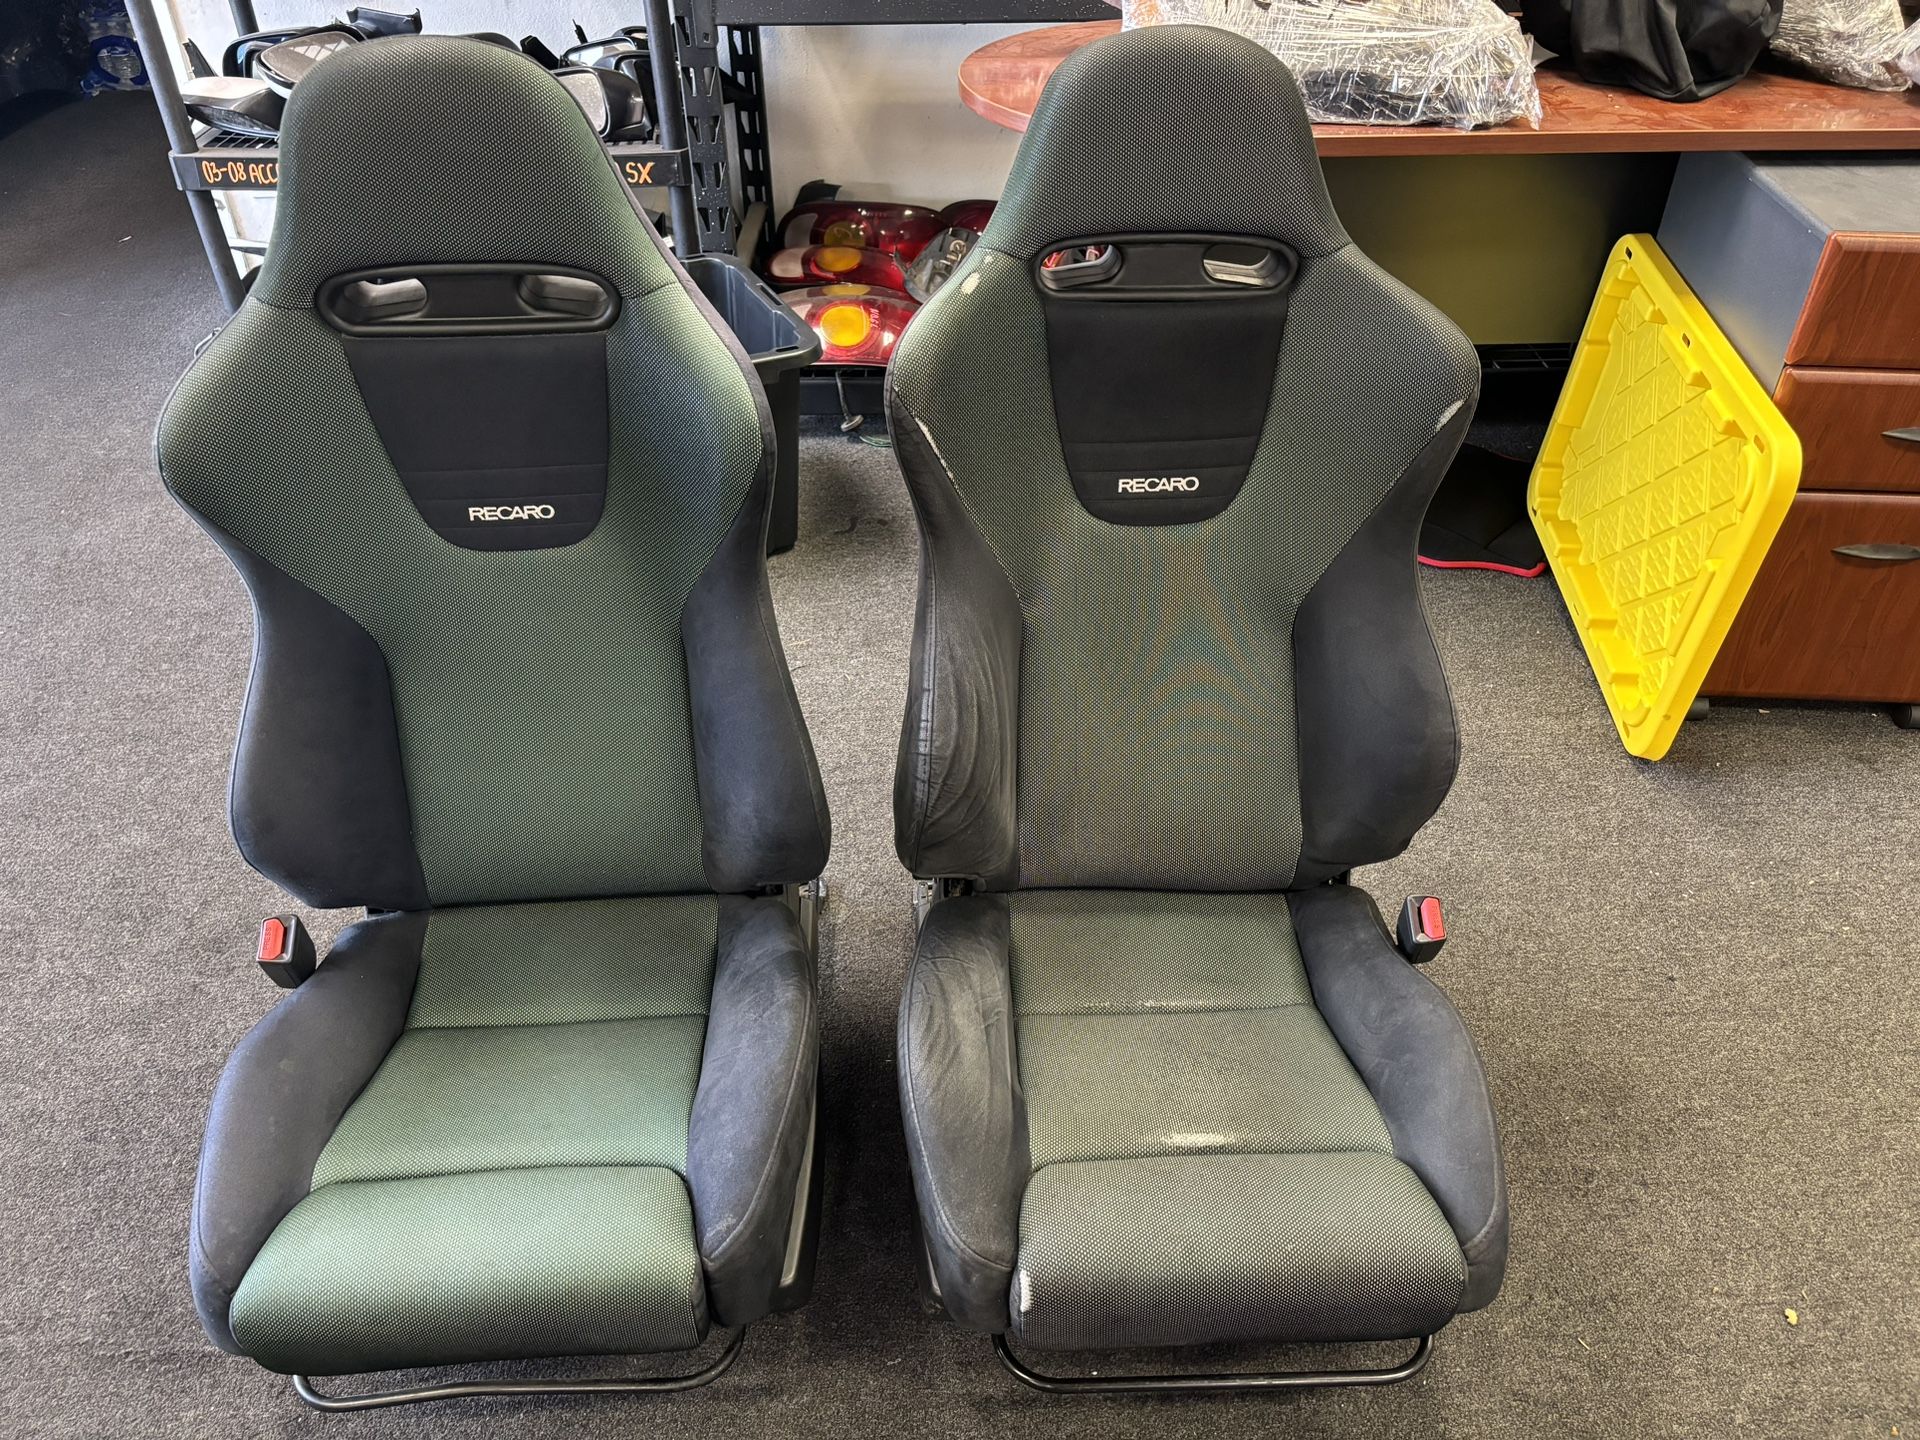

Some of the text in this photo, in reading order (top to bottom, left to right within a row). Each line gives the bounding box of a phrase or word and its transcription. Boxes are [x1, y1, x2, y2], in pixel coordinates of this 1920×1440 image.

[202, 160, 247, 183] 03-08
[625, 161, 655, 184] SX
[1117, 476, 1200, 493] RECARO
[467, 504, 555, 521] RECARO
